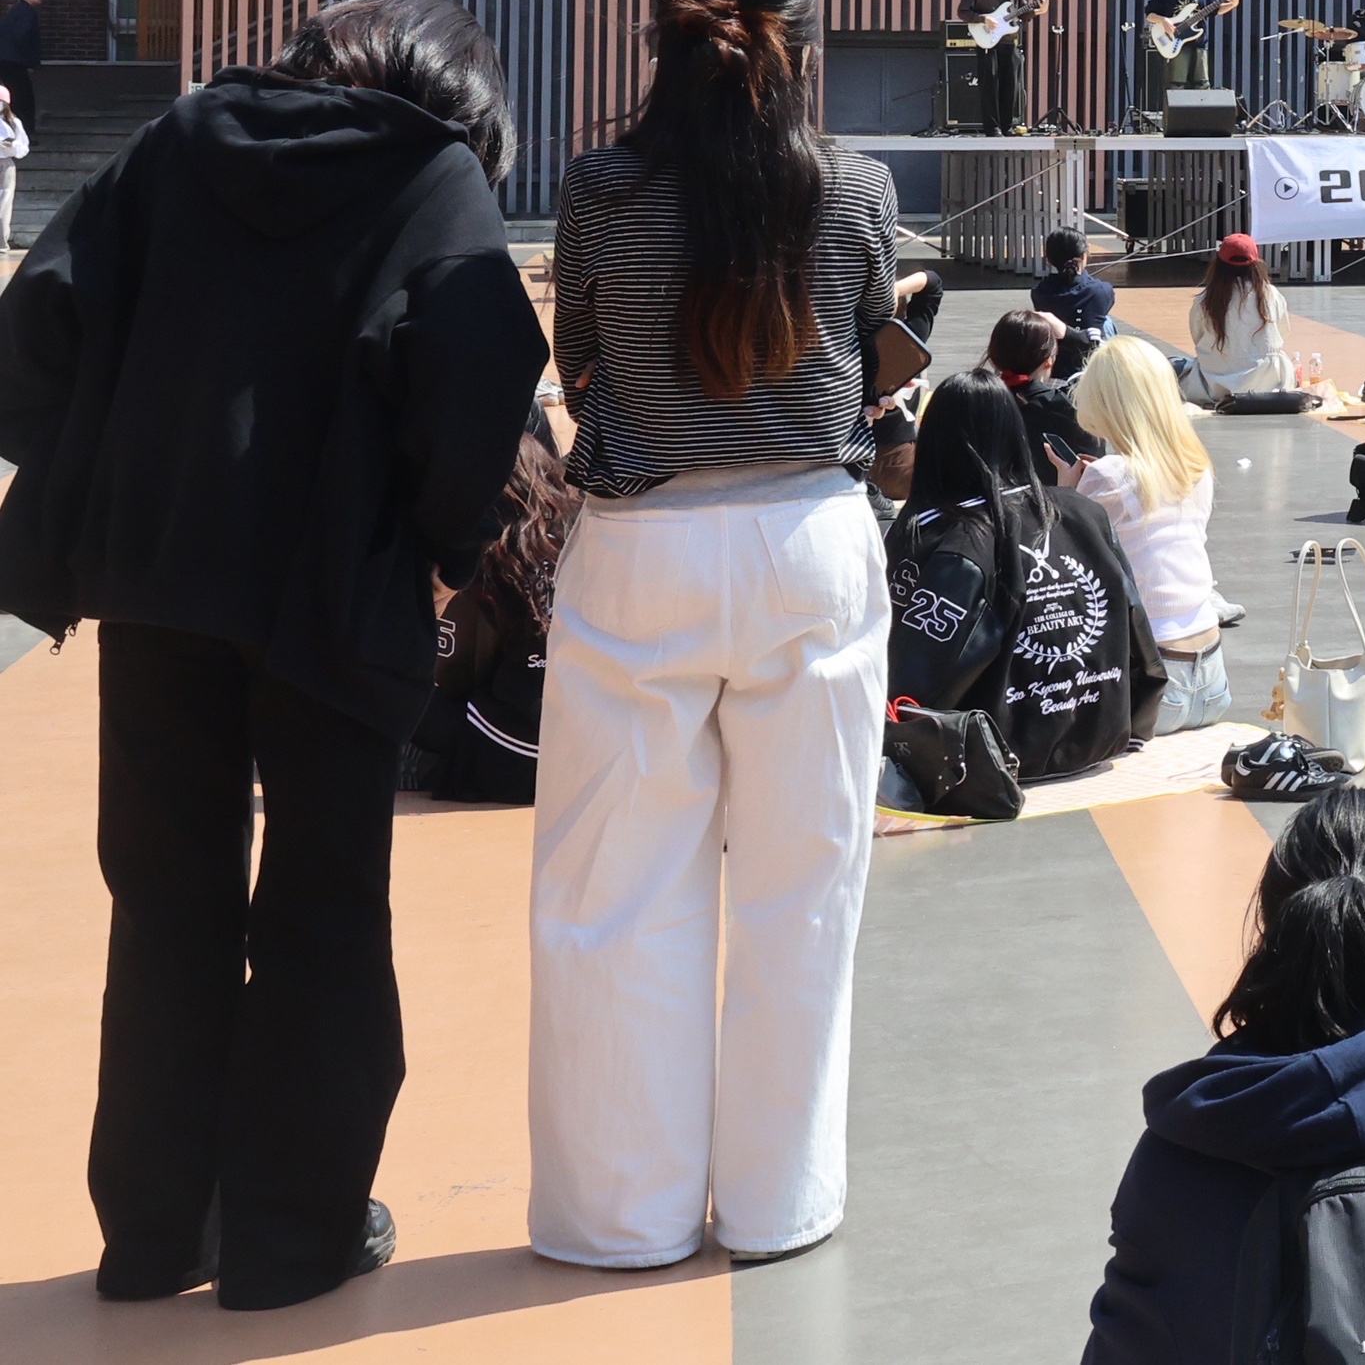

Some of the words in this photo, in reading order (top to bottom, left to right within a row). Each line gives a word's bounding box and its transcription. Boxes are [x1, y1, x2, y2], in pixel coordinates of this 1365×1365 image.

[1027, 619, 1066, 635] BEAUTY
[1067, 615, 1084, 627] ART
[1075, 666, 1122, 685] University
[1040, 696, 1077, 715] Beauty
[1077, 689, 1100, 706] Art
